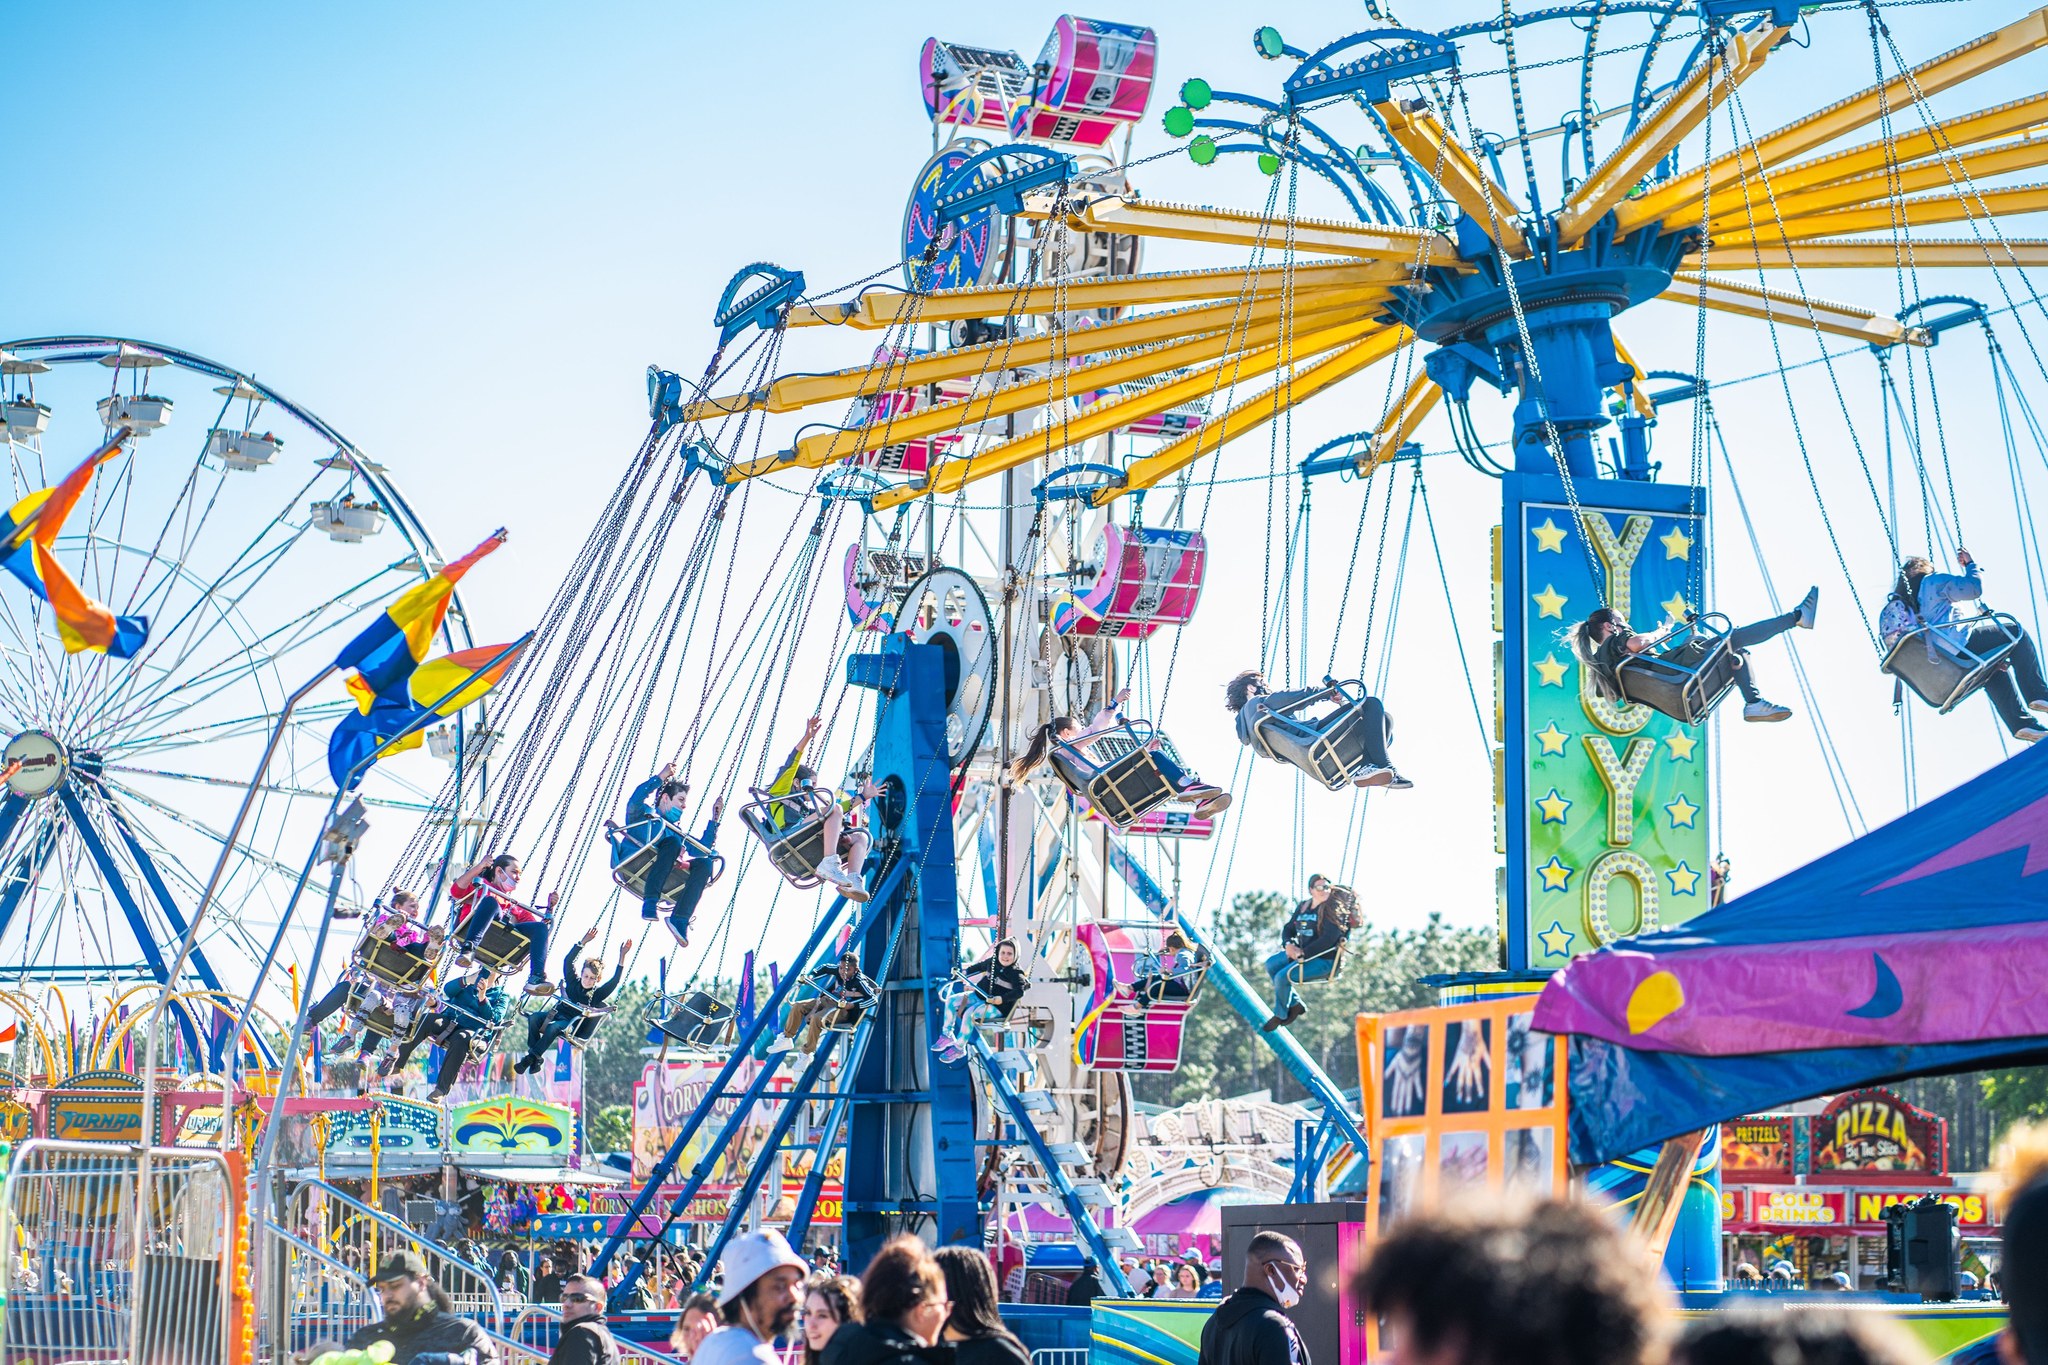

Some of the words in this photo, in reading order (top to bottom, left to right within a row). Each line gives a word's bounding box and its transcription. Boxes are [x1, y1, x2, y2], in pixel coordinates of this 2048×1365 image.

[58, 1110, 142, 1133] TORNAD
[1836, 1101, 1907, 1148] PIZZA
[1736, 1126, 1780, 1142] PRETZELS
[1844, 1142, 1859, 1161] By
[663, 1198, 727, 1216] NCHOS
[1769, 1192, 1825, 1207] COLD
[1760, 1207, 1834, 1223] DRINKS
